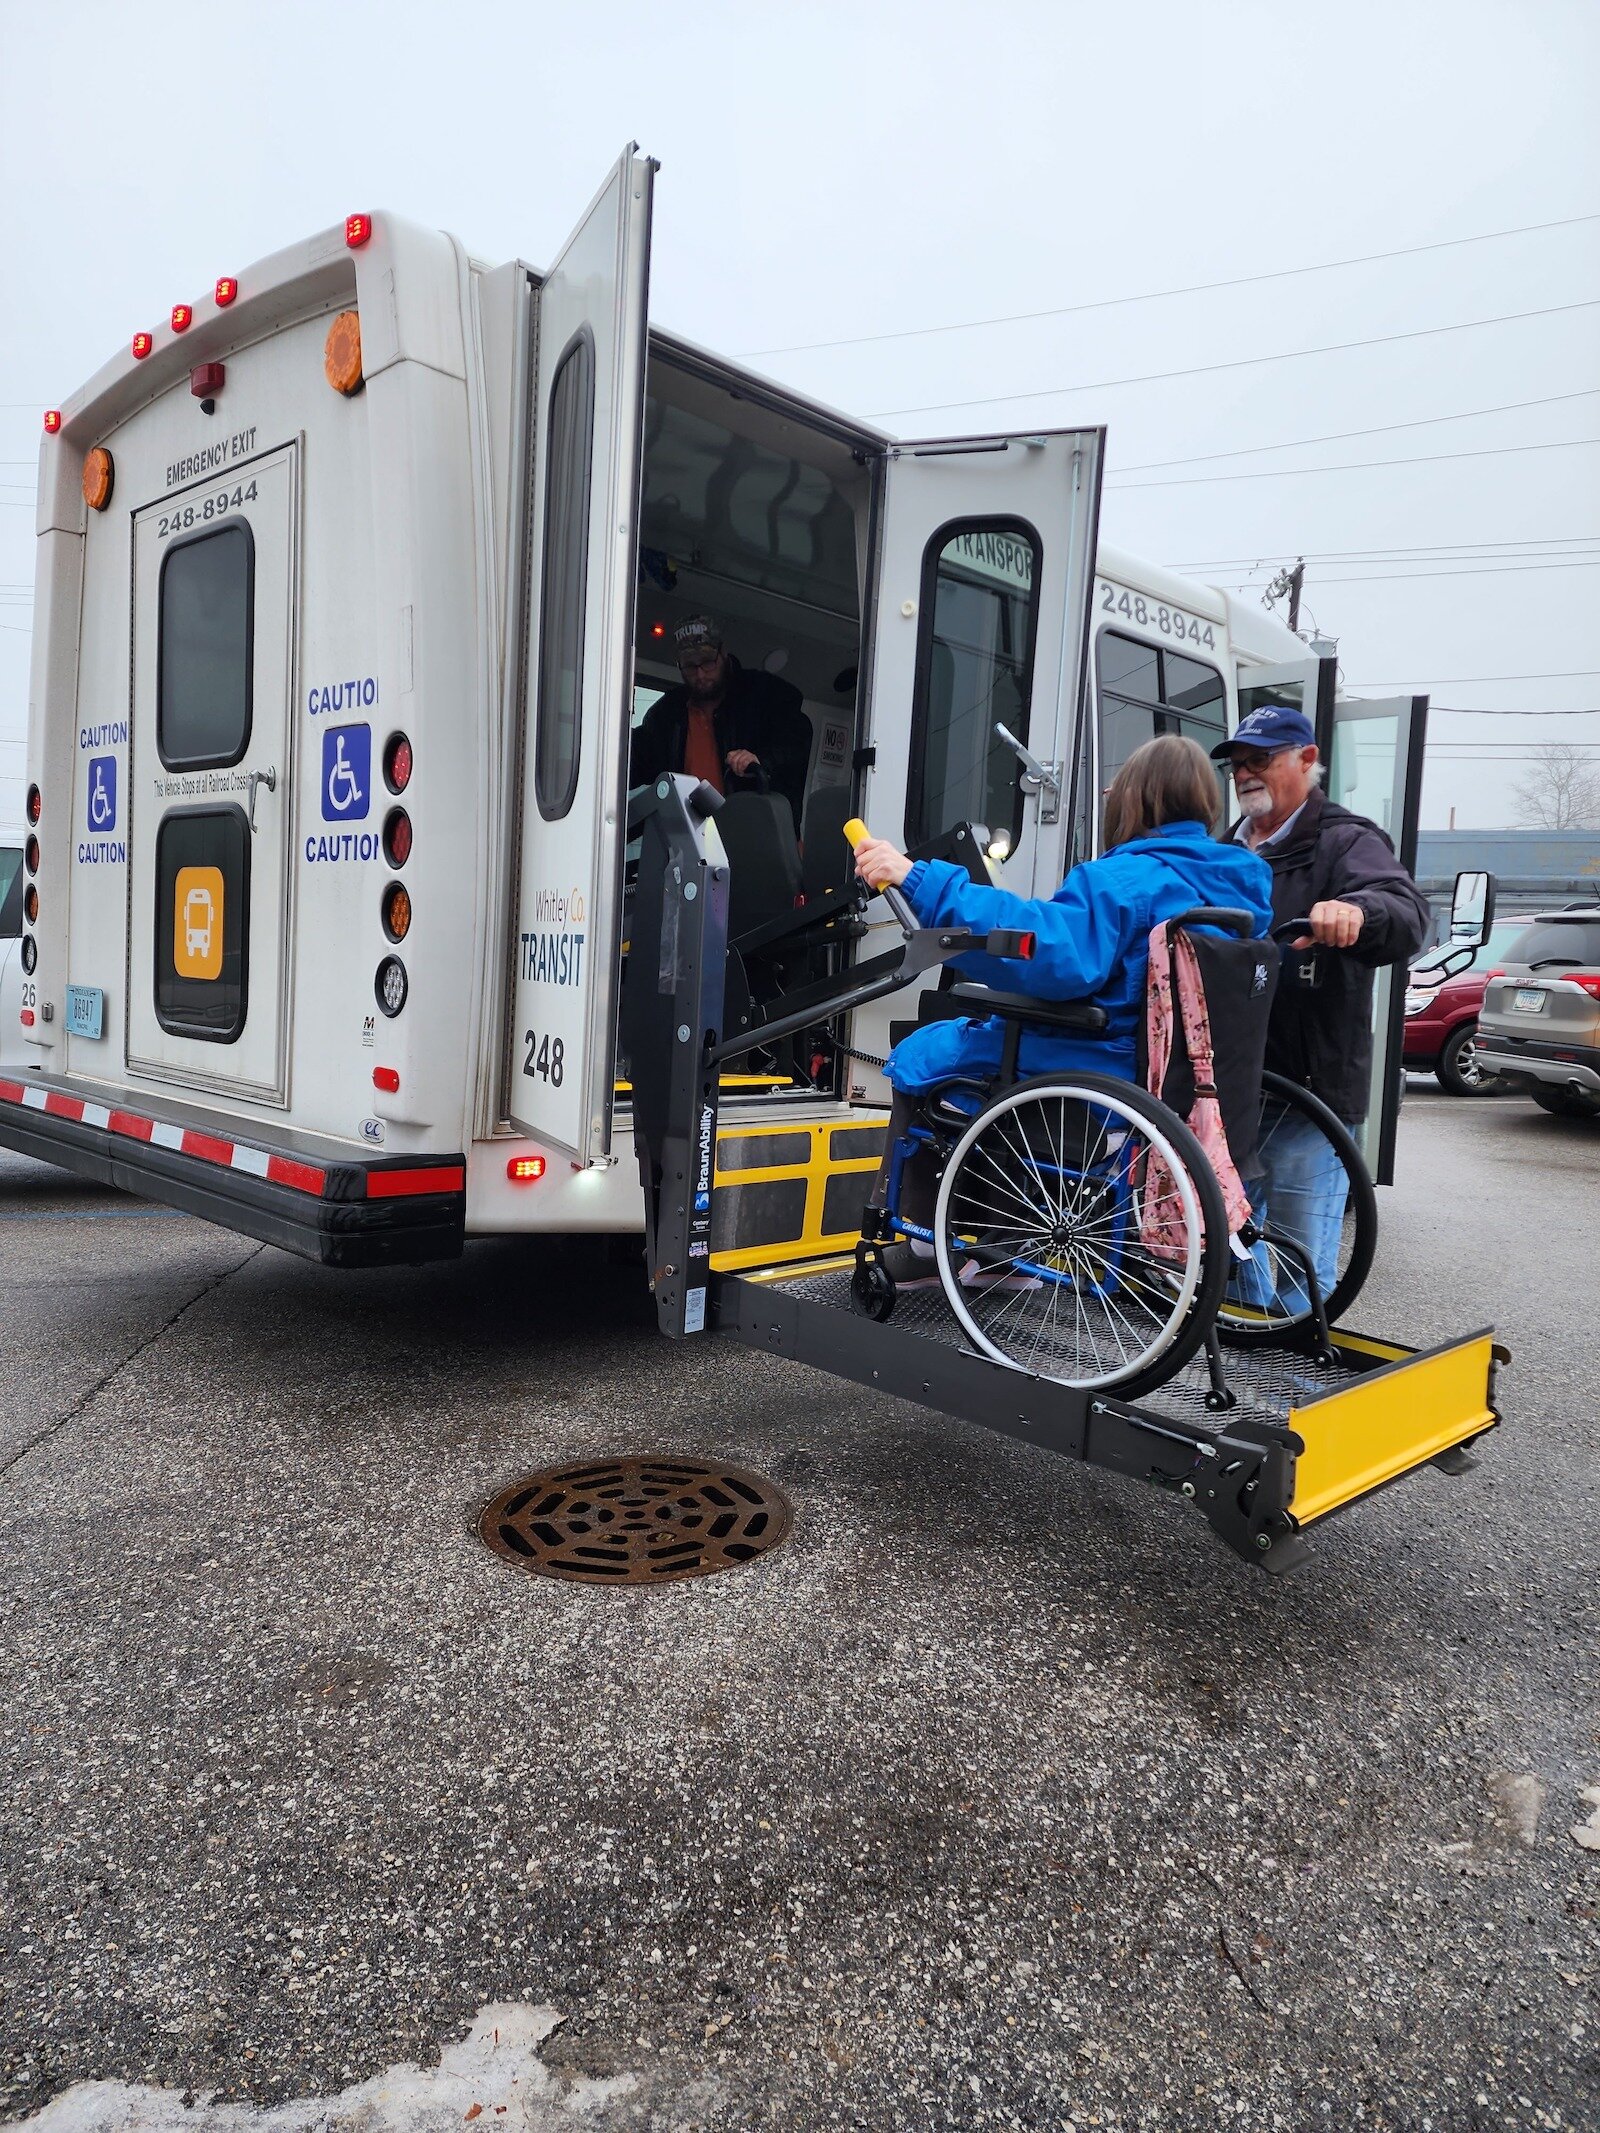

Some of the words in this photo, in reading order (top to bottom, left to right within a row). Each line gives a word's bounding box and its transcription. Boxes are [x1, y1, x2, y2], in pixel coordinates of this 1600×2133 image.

[166, 440, 228, 487] EMERGENCY
[231, 426, 257, 458] EXIT
[157, 479, 258, 539] 248-8944
[674, 623, 708, 640] TRUMP
[1100, 582, 1216, 652] 248-8944
[309, 676, 378, 715] CAUTIO
[80, 721, 127, 749] CAUTION
[825, 728, 837, 747] NO
[154, 779, 164, 797] This
[165, 777, 181, 797] Vehicle
[181, 776, 196, 799] Stops
[209, 772, 230, 792] Railroad
[78, 841, 126, 864] CAUTION
[535, 888, 570, 931] Whitley
[570, 887, 585, 923] Co.
[521, 932, 585, 988] TRANSIT
[22, 983, 36, 1008] 26
[522, 1028, 565, 1088] 248
[697, 1105, 714, 1191] BraunAbility
[902, 1223, 932, 1237] CATALYST
